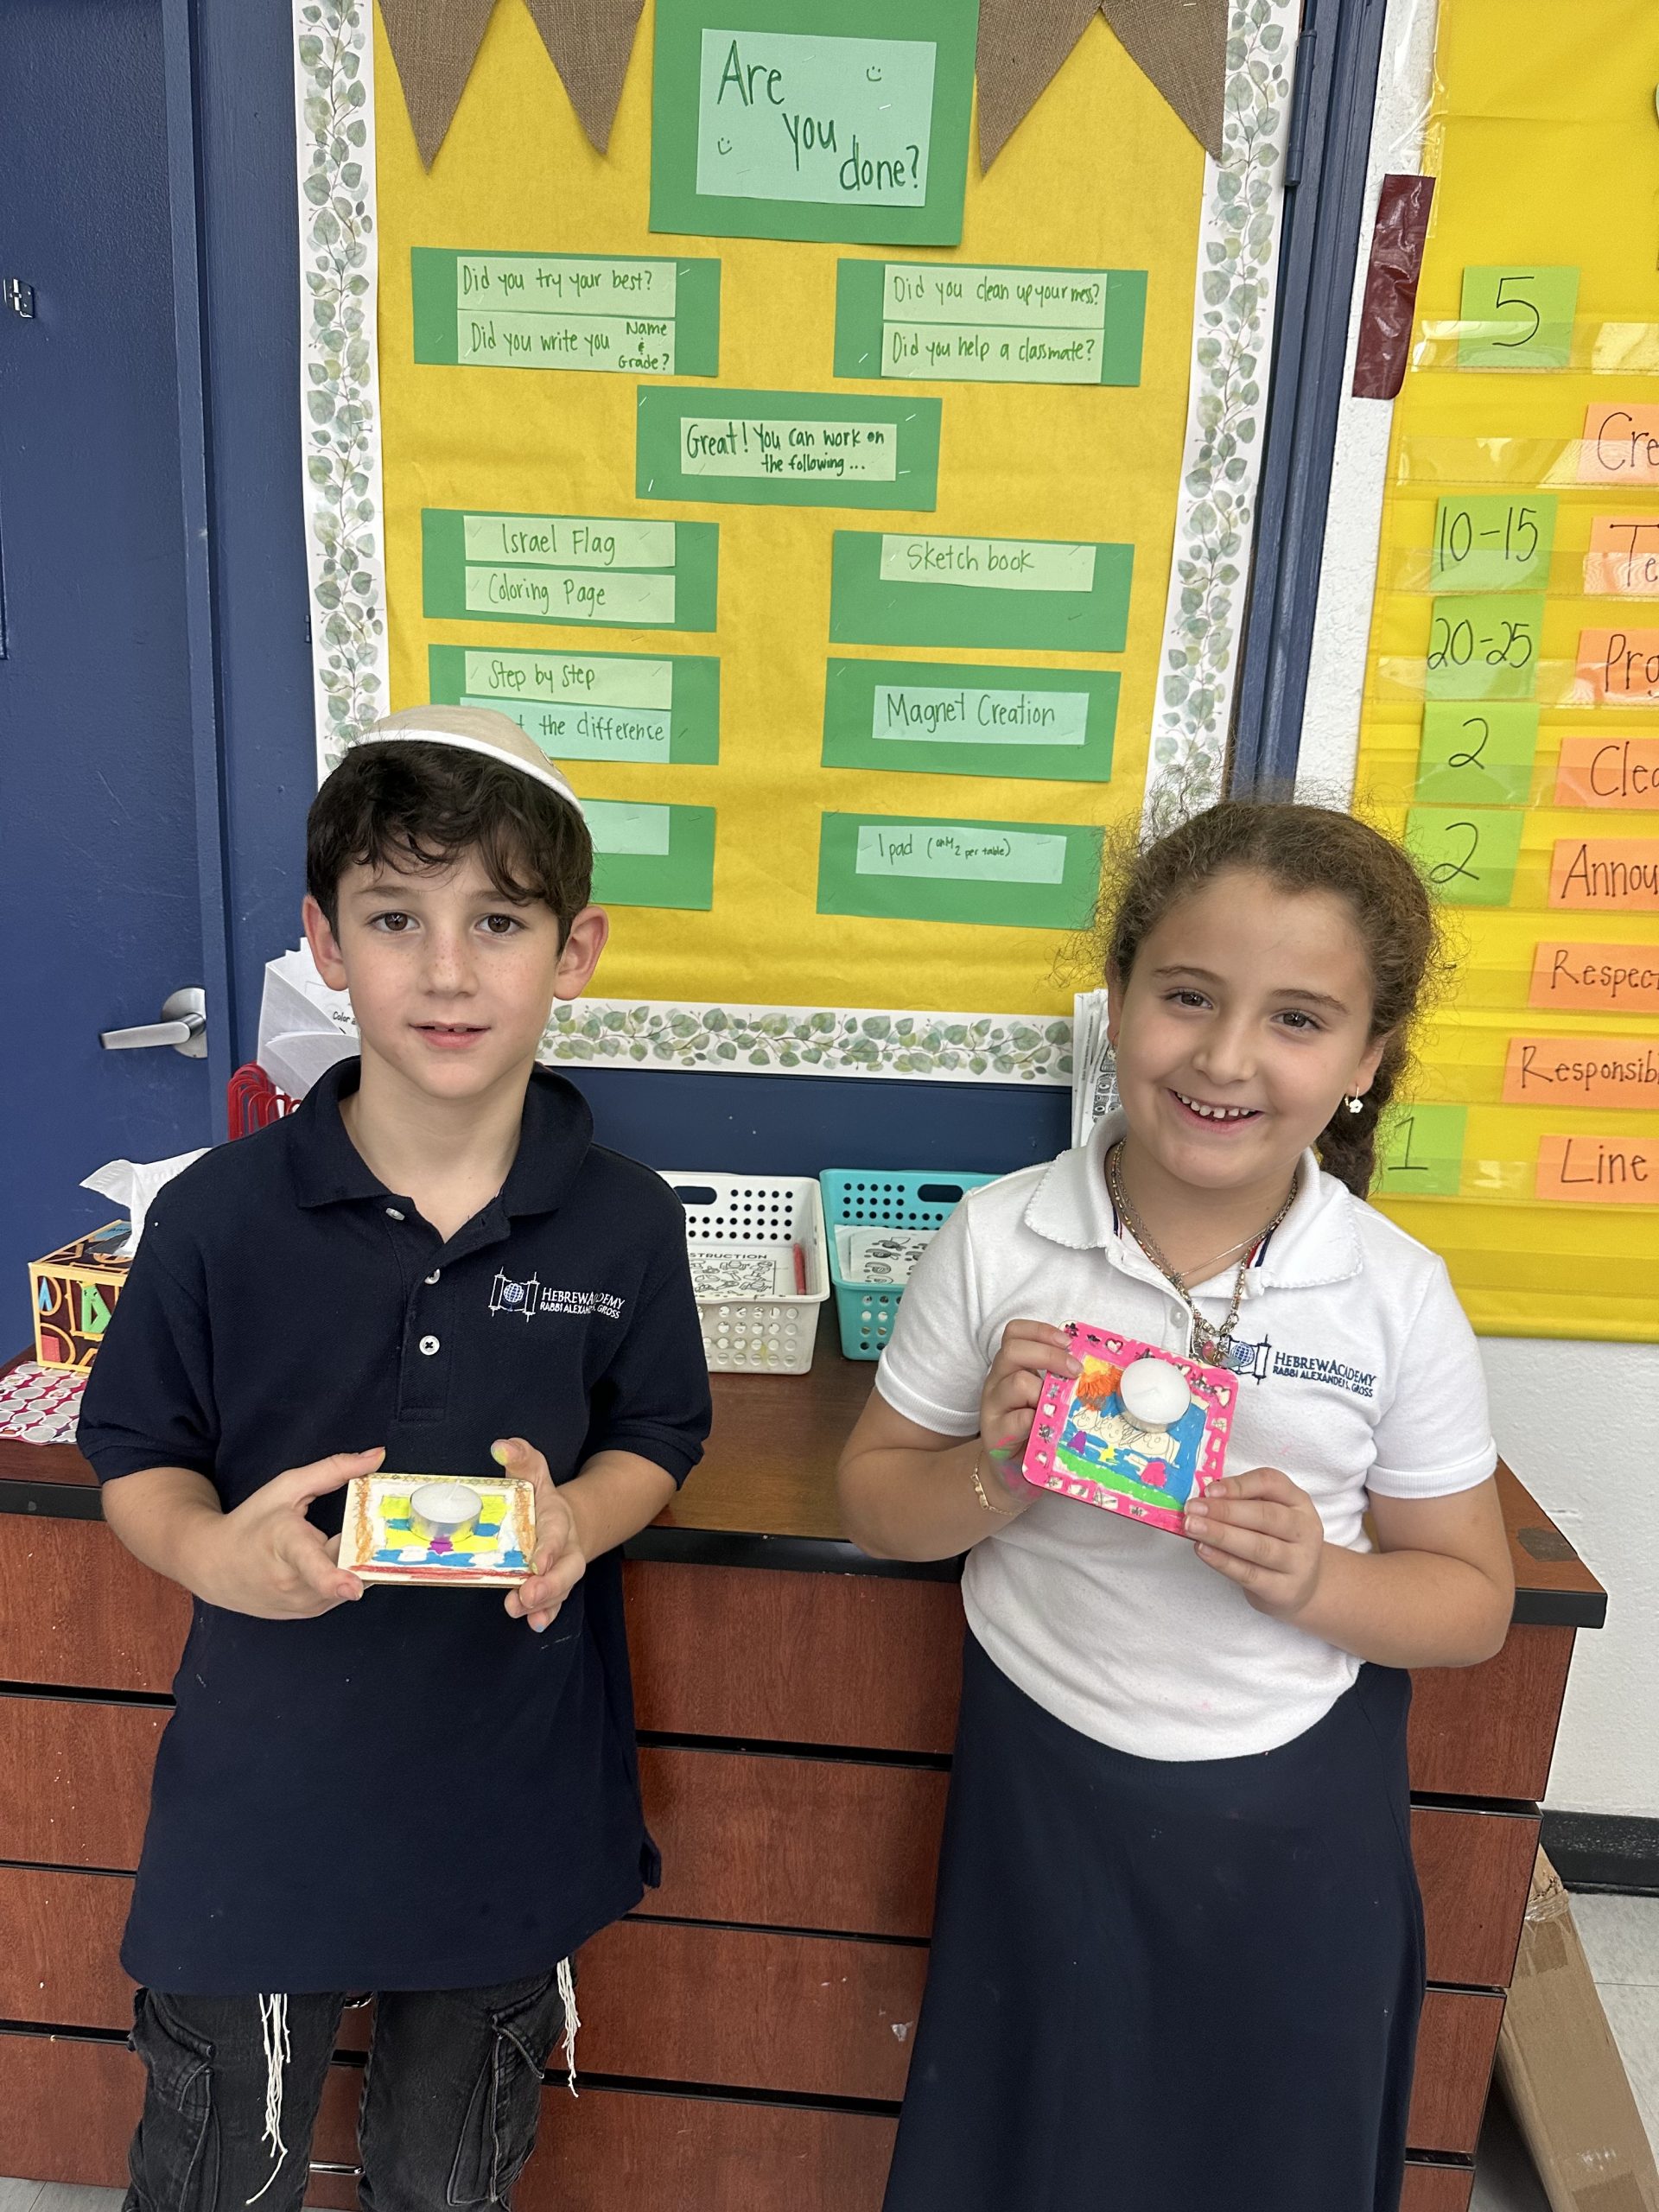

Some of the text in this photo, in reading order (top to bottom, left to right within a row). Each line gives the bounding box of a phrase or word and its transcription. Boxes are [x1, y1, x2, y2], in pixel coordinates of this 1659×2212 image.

[716, 40, 785, 106] Are
[782, 112, 836, 171] you
[839, 135, 919, 191] done?
[463, 264, 653, 298] Did you try your best?
[893, 275, 925, 302] Did
[935, 281, 963, 305] you
[976, 276, 1009, 302] clean
[1071, 283, 1100, 305] mess?
[626, 321, 668, 336] Name
[1492, 276, 1541, 347] 5
[471, 320, 610, 357] Did you write you
[892, 332, 1096, 366] Did you help a classmate?
[618, 353, 670, 371] Grade?
[687, 421, 749, 459] Great!
[823, 428, 861, 448] work
[867, 430, 885, 445] on
[761, 454, 784, 474] the
[502, 523, 616, 566] Israel Flag
[907, 541, 1035, 573] Sketch book
[1440, 506, 1539, 572] 10-15
[488, 573, 607, 618] Coloring Page
[1427, 618, 1532, 670] 20-25
[488, 659, 526, 691] Step
[535, 663, 555, 694] by
[1605, 633, 1659, 697] Pro
[539, 714, 566, 737] the
[576, 711, 665, 741] difference
[887, 692, 1055, 734] Magnet Creation
[1448, 717, 1489, 770] 2
[955, 845, 961, 856] 2
[965, 849, 979, 859] per
[1429, 822, 1479, 884] 2
[333, 1011, 350, 1022] Color
[1521, 1046, 1659, 1091] Responsib
[1387, 1116, 1428, 1171] 1
[1560, 1138, 1648, 1184] Line
[540, 1301, 563, 1313] RABBI
[597, 1305, 620, 1319] GROSS
[1273, 1366, 1299, 1378] RABBI
[1351, 1383, 1373, 1397] GROSS
